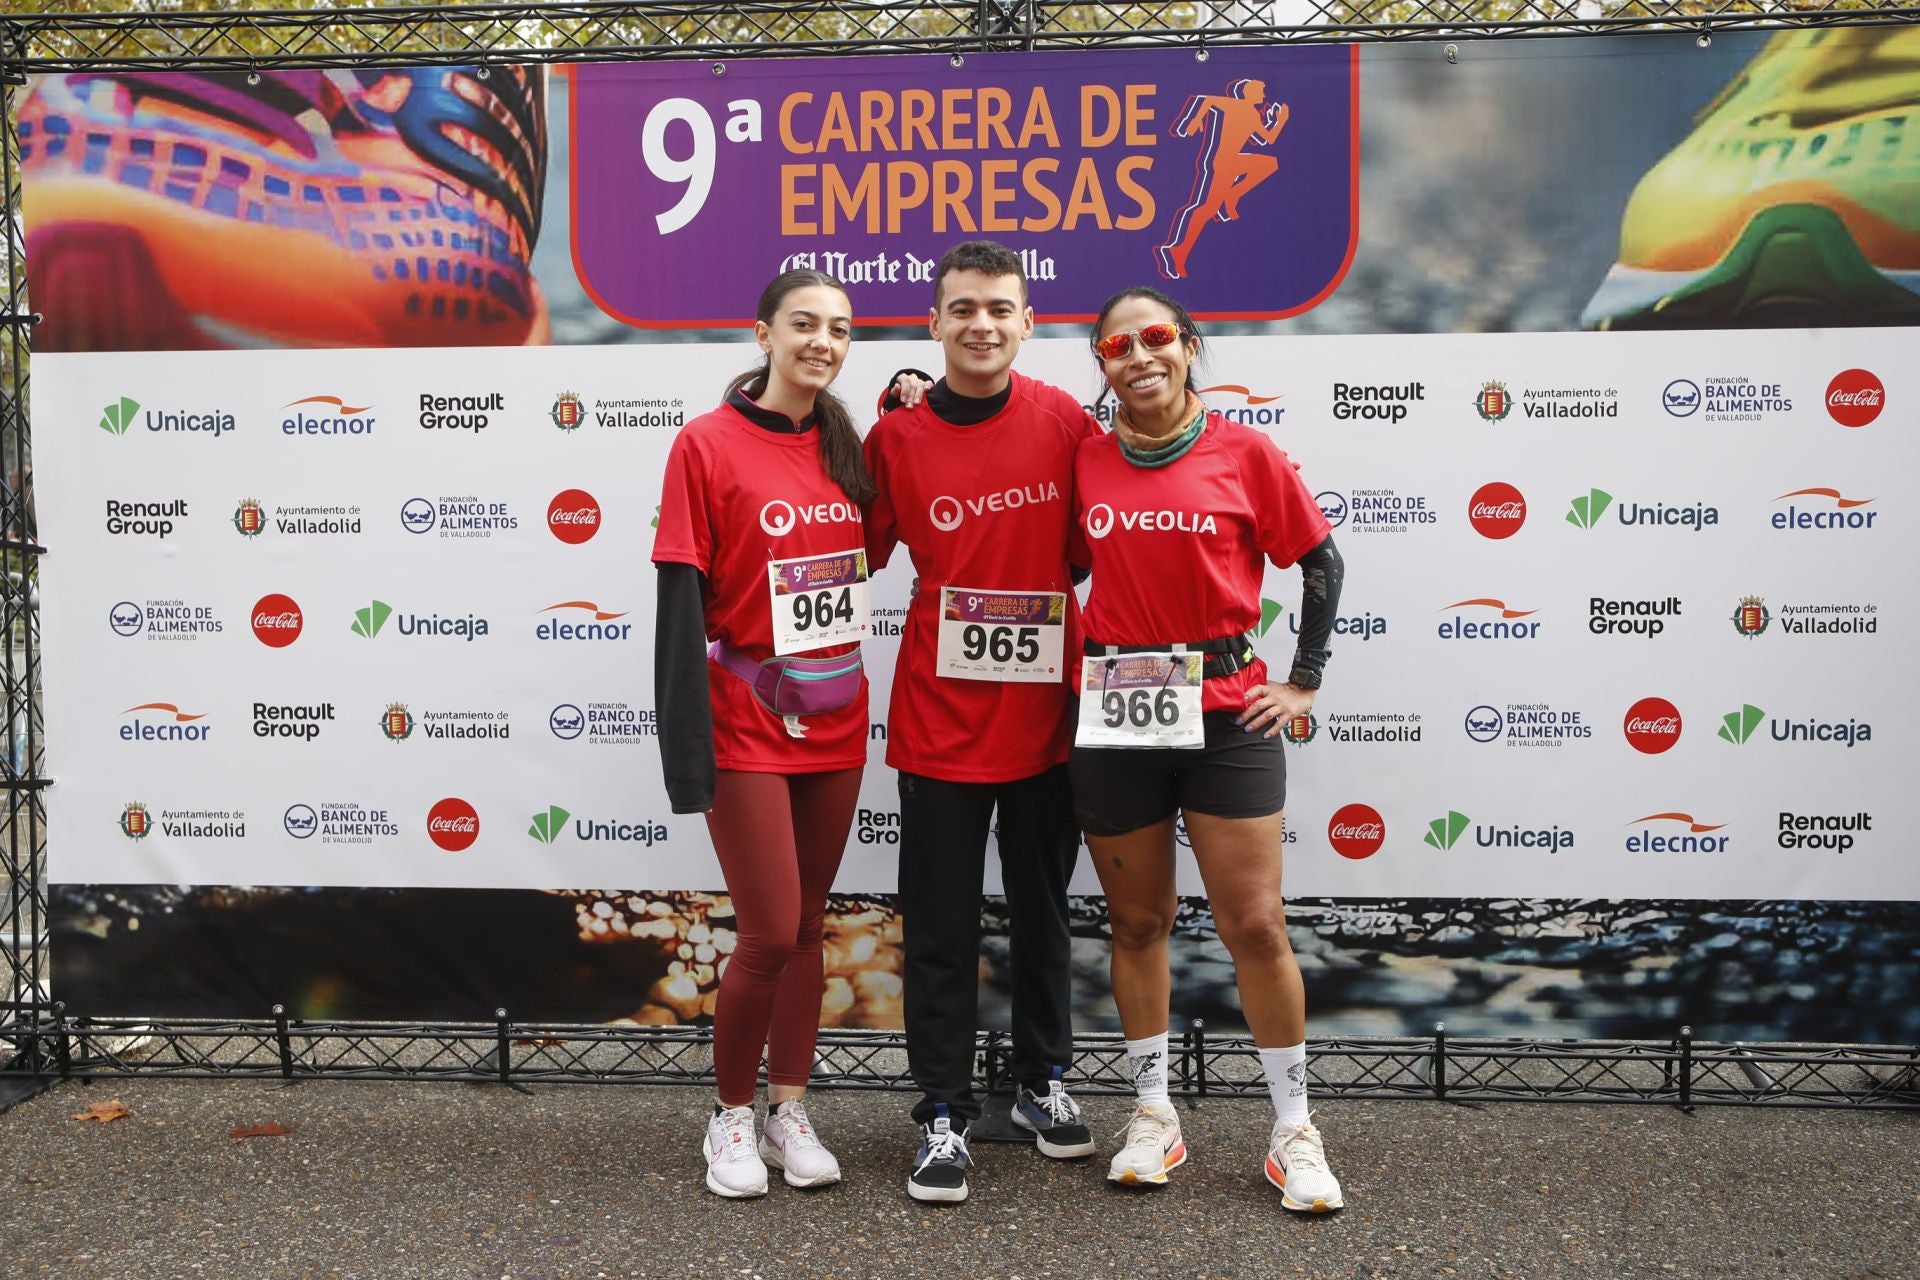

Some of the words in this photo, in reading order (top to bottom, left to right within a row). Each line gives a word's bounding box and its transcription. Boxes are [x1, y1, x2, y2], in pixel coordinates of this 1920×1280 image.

[779, 86, 1059, 154] CARRERA
[1080, 84, 1158, 147] DE
[780, 155, 1157, 236] EMPRESAS
[821, 252, 901, 285] Norte
[905, 252, 936, 284] de
[1706, 376, 1749, 384] FUNDACIÓN
[1333, 382, 1424, 402] Renault
[1523, 388, 1601, 401] Ayuntamiento
[1604, 388, 1618, 398] de
[1706, 385, 1756, 398] BANCO
[1761, 385, 1781, 397] DE
[420, 393, 504, 412] Renault
[596, 398, 668, 411] Ayuntamiento
[671, 398, 684, 409] de
[1523, 401, 1618, 418] Valladolid
[1706, 399, 1792, 412] ALIMENTOS
[596, 411, 684, 429] Valladolid
[1333, 401, 1407, 424] Group
[146, 409, 235, 437] Unicaja
[282, 413, 375, 435] elecnor
[420, 411, 488, 434] Group
[966, 481, 1060, 516] VEOLIA
[1352, 489, 1394, 497] FUNDACIÓN
[107, 499, 188, 517] Renault
[276, 506, 345, 517] Ayuntamiento
[349, 506, 361, 516] de
[440, 504, 485, 516] BANCO
[490, 504, 507, 515] DE
[1352, 497, 1401, 510] BANCO
[1407, 497, 1425, 510] DE
[276, 517, 361, 534] Valladolid
[440, 517, 518, 529] ALIMENTOS
[1120, 510, 1217, 536] VEOLIA
[1352, 511, 1437, 524] ALIMENTOS
[1619, 502, 1718, 532] Unicaja
[1772, 505, 1877, 529] elecnor
[107, 516, 172, 539] Group
[807, 561, 833, 572] CARRERA
[835, 559, 841, 568] DE
[807, 568, 842, 581] EMPRESAS
[793, 587, 853, 631] 964
[984, 597, 1017, 606] CARRERA
[1019, 598, 1028, 606] DE
[984, 605, 1028, 615] EMPRESAS
[1589, 597, 1682, 617] Renault
[1781, 604, 1860, 615] Ayuntamiento
[1864, 604, 1877, 614] de
[147, 607, 191, 619] BANCO
[195, 607, 212, 619] DE
[148, 621, 223, 632] ALIMENTOS
[398, 614, 488, 642] Unicaja
[536, 617, 631, 640] elecnor
[1438, 616, 1540, 639] elecnor
[1589, 616, 1664, 639] Group
[1781, 616, 1877, 634] Valladolid
[963, 624, 1039, 663] 965
[1120, 660, 1152, 669] CARRERA
[1120, 668, 1163, 678] EMPRESAS
[253, 703, 335, 721] Renault
[424, 710, 493, 722] Ayuntamiento
[497, 710, 509, 720] de
[589, 710, 634, 722] BANCO
[639, 710, 657, 722] DE
[1104, 689, 1179, 728] 966
[1329, 713, 1404, 725] Ayuntamiento
[1408, 713, 1421, 723] de
[1507, 712, 1556, 724] BANCO
[1562, 712, 1580, 724] DE
[120, 719, 210, 741] elecnor
[253, 720, 319, 742] Group
[424, 722, 509, 740] Valladolid
[589, 724, 658, 735] ALIMENTO
[1329, 725, 1421, 742] Valladolid
[1507, 726, 1591, 738] ALIMENTOS
[1771, 718, 1871, 747] Unicaja
[162, 810, 229, 821] Ayuntamiento
[233, 810, 245, 820] de
[321, 810, 366, 822] BANCO
[371, 810, 388, 822] DE
[1778, 812, 1872, 832] Renault
[162, 821, 245, 838] Valladolid
[322, 824, 398, 835] ALIMENTOS
[576, 819, 667, 847] Unicaja
[858, 826, 899, 844] Gro
[1477, 825, 1574, 854] Unicaja
[1626, 829, 1729, 853] elecnor
[1778, 831, 1854, 854] Group
